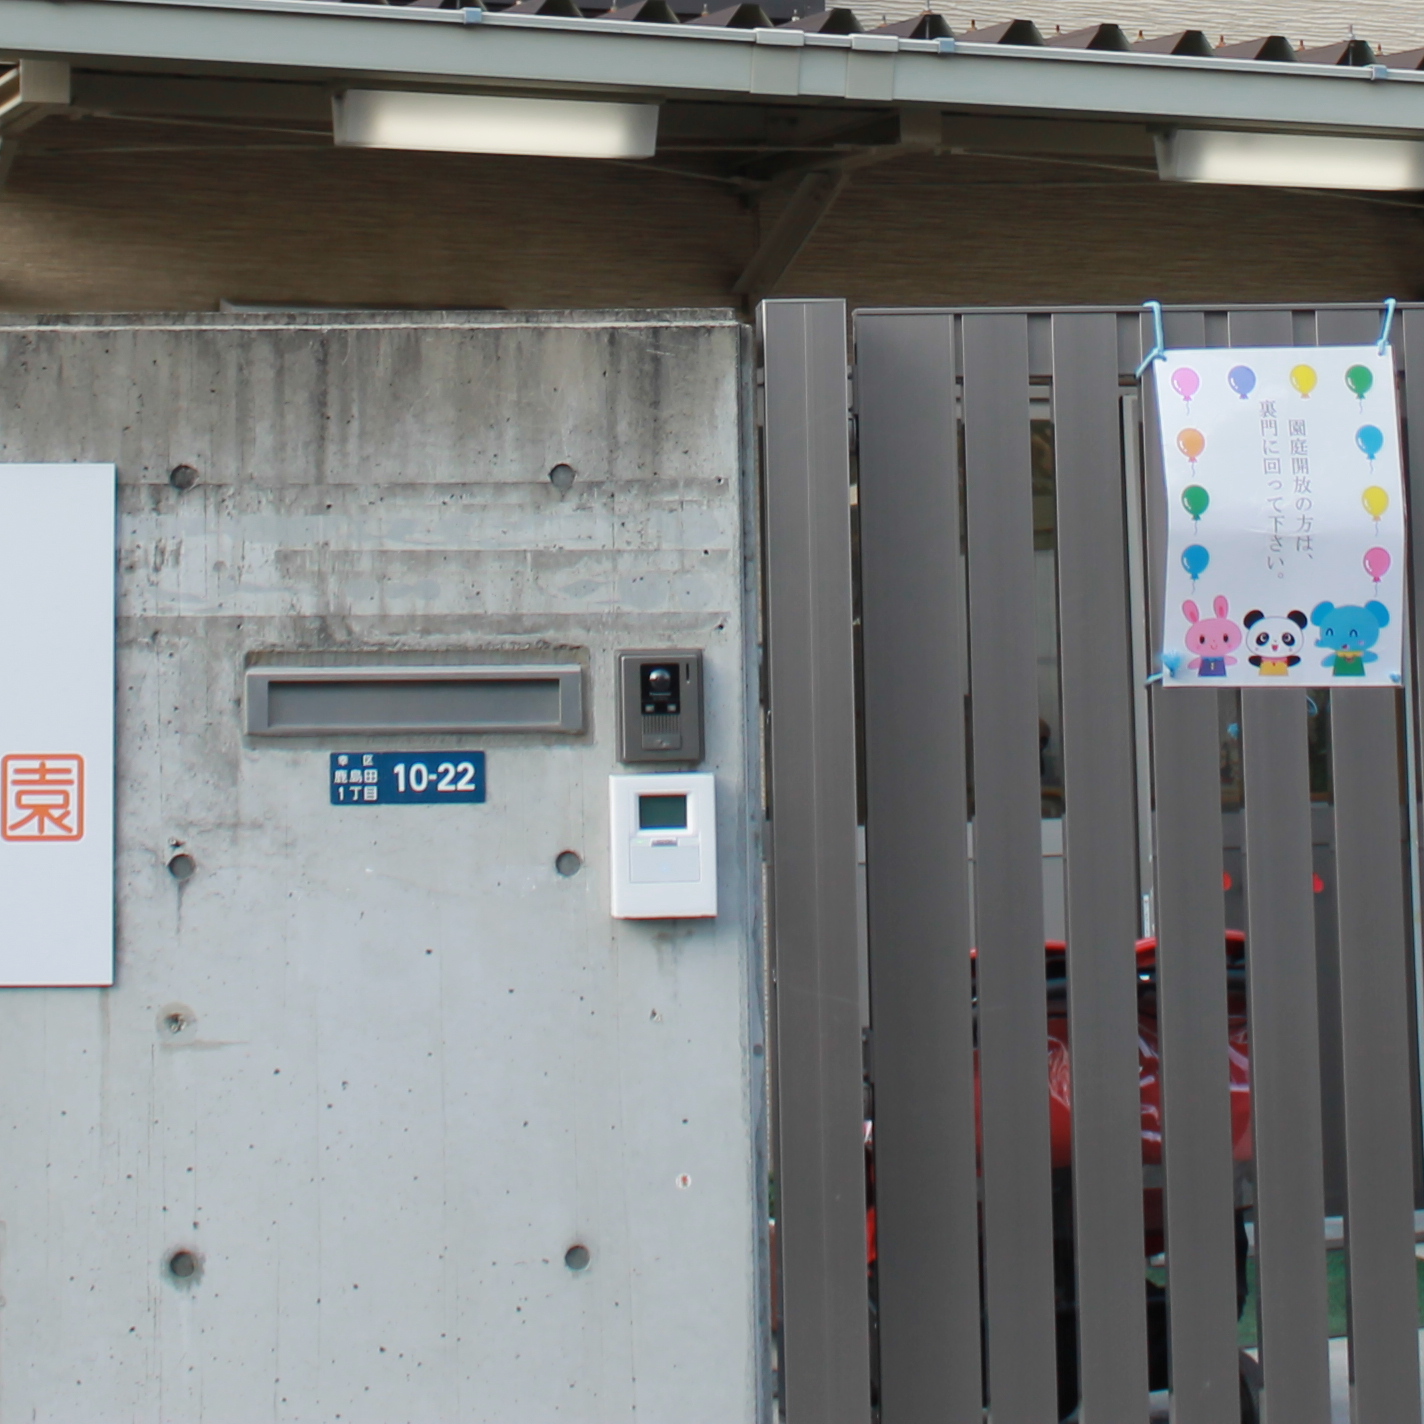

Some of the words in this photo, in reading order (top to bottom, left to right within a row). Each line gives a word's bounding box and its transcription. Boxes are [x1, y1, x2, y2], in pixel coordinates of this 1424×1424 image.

[1259, 399, 1285, 580] 裏門に回って下さい。
[1288, 419, 1314, 560] 園庭開放の方は、
[333, 768, 378, 784] 鹿島田
[393, 761, 476, 793] 10-22
[337, 785, 378, 802] 1丁目
